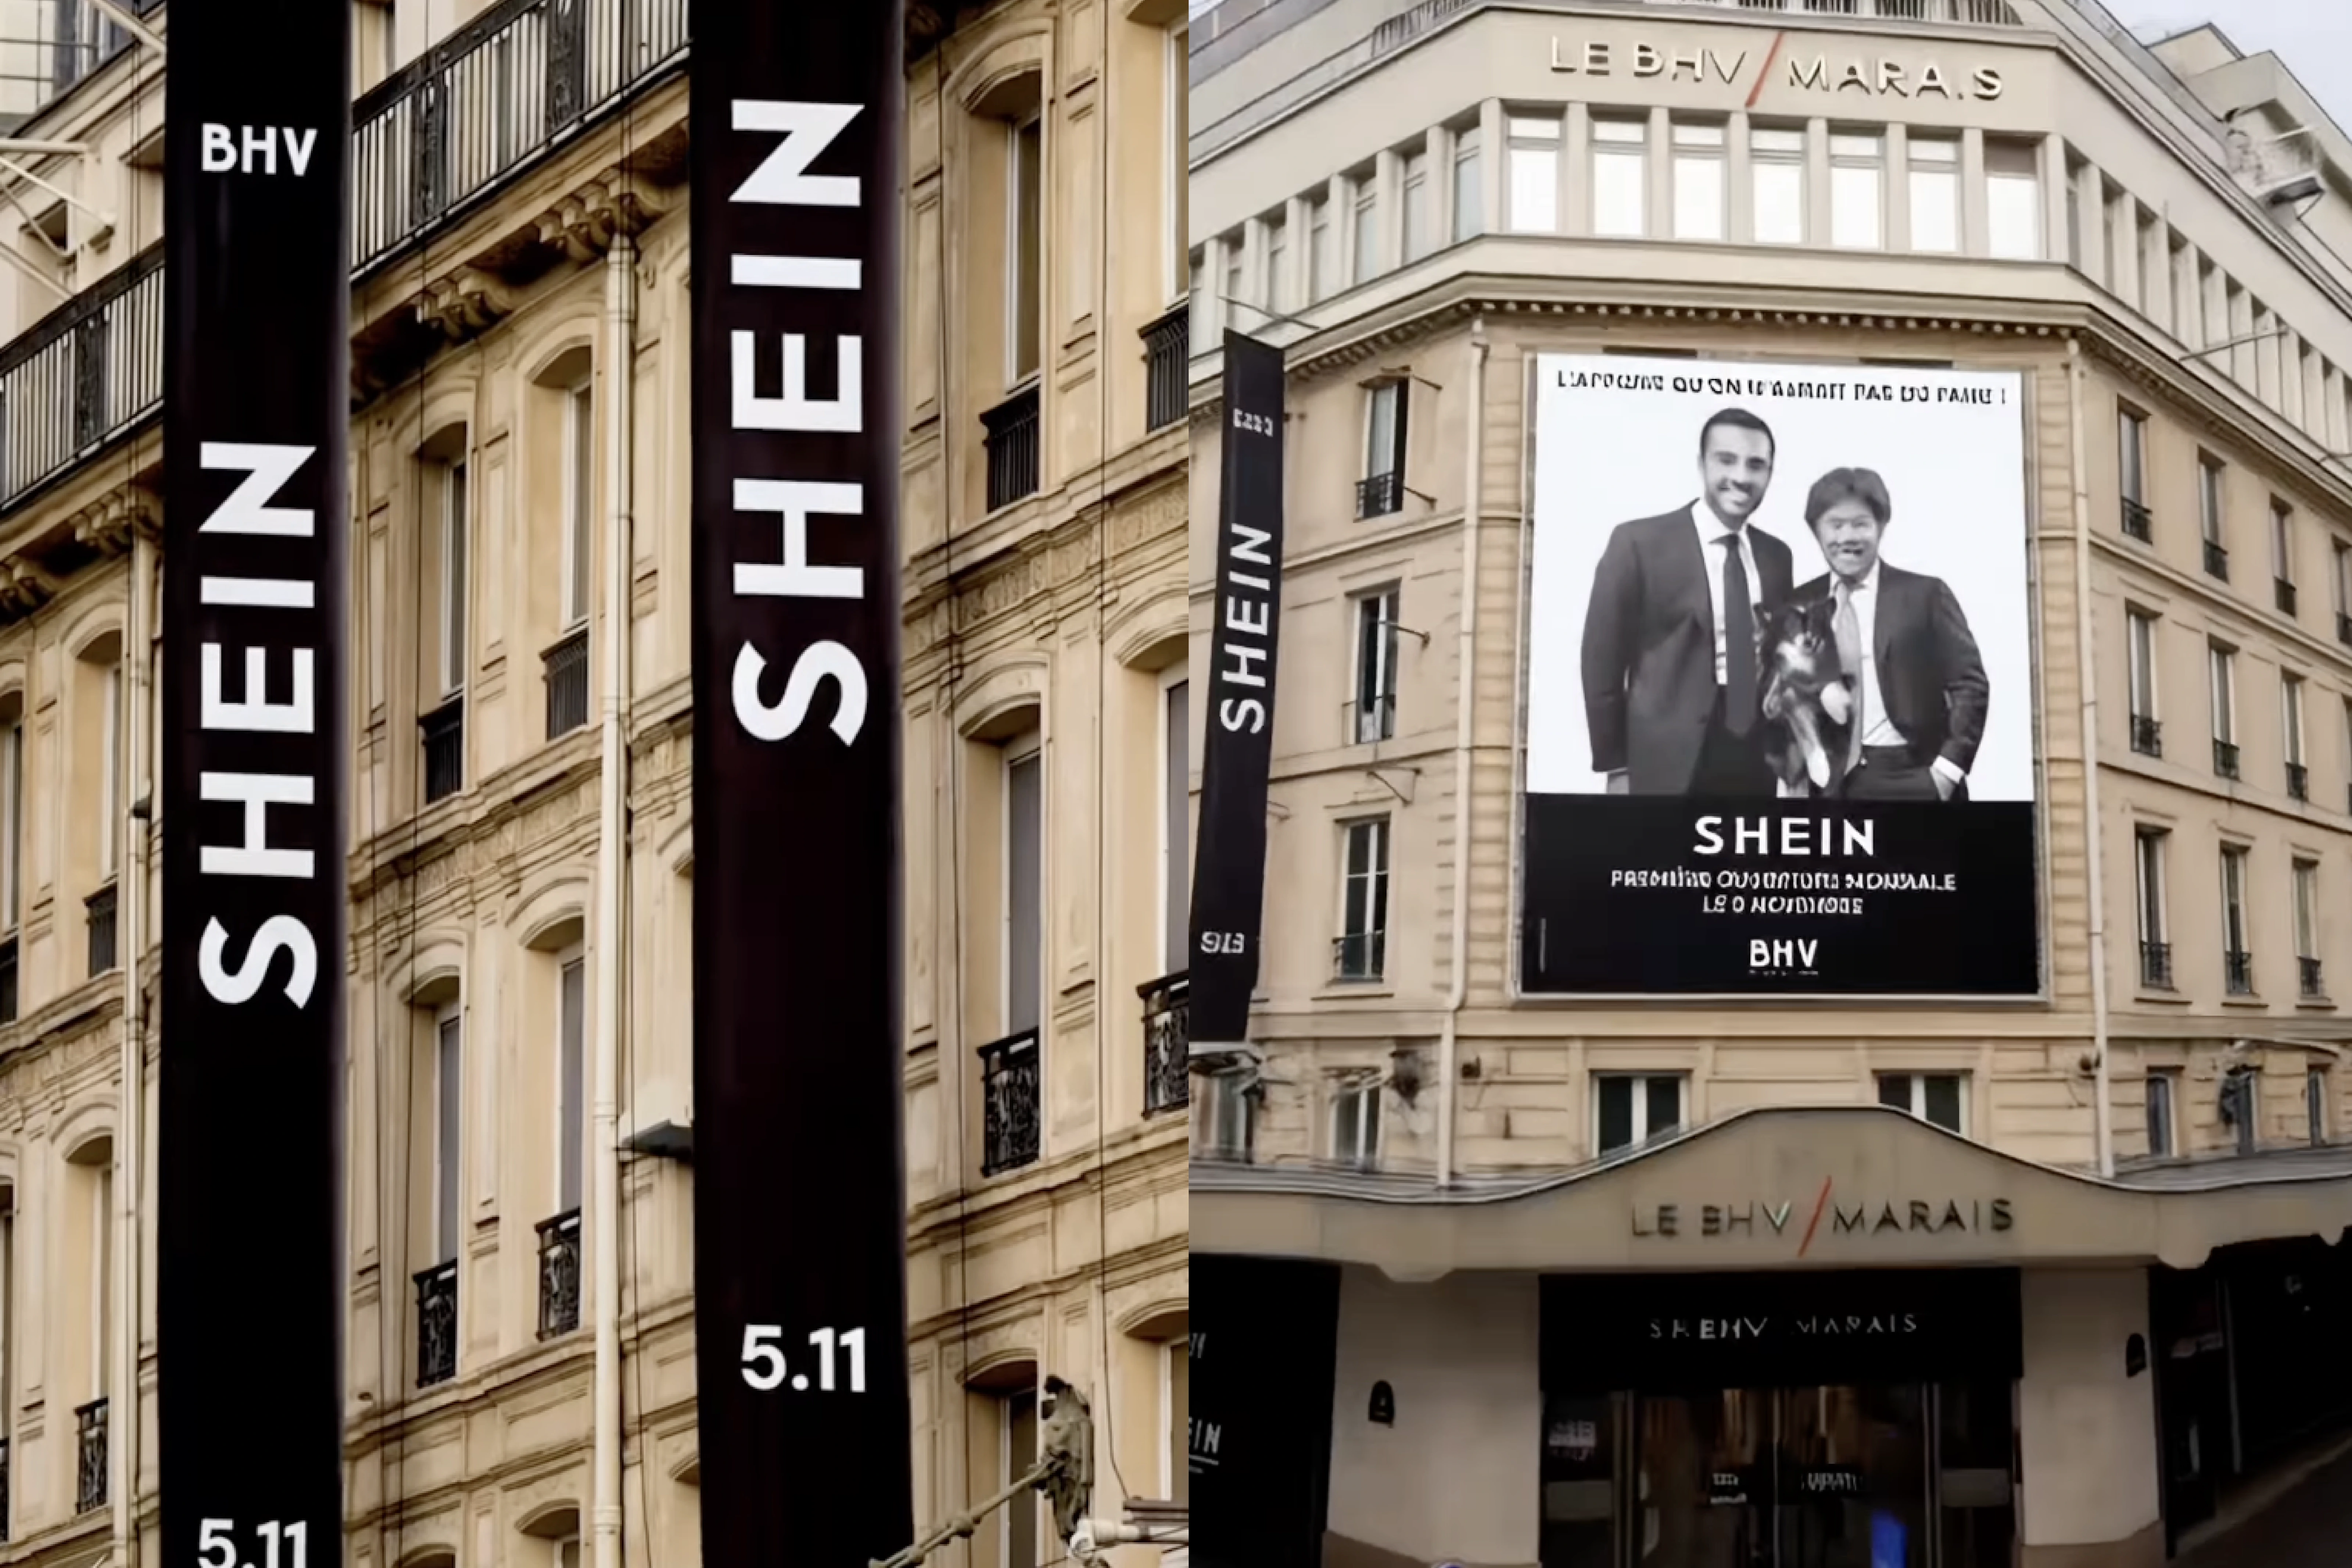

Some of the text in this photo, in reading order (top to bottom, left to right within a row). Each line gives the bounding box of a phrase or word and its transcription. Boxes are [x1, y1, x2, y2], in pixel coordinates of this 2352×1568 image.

[1551, 35, 2004, 101] LE BHV MARAS
[202, 122, 317, 176] BHV
[729, 99, 868, 746] SHEIN
[1219, 523, 1272, 734] SHEIN
[198, 441, 317, 1009] SHEIN
[1693, 815, 1874, 855] SHEIN
[1750, 938, 1818, 968] BHV
[1631, 1202, 1678, 1237] LE
[1833, 1198, 2014, 1235] MARAIS
[741, 1324, 865, 1393] 5.11
[198, 1518, 306, 1568] 511
